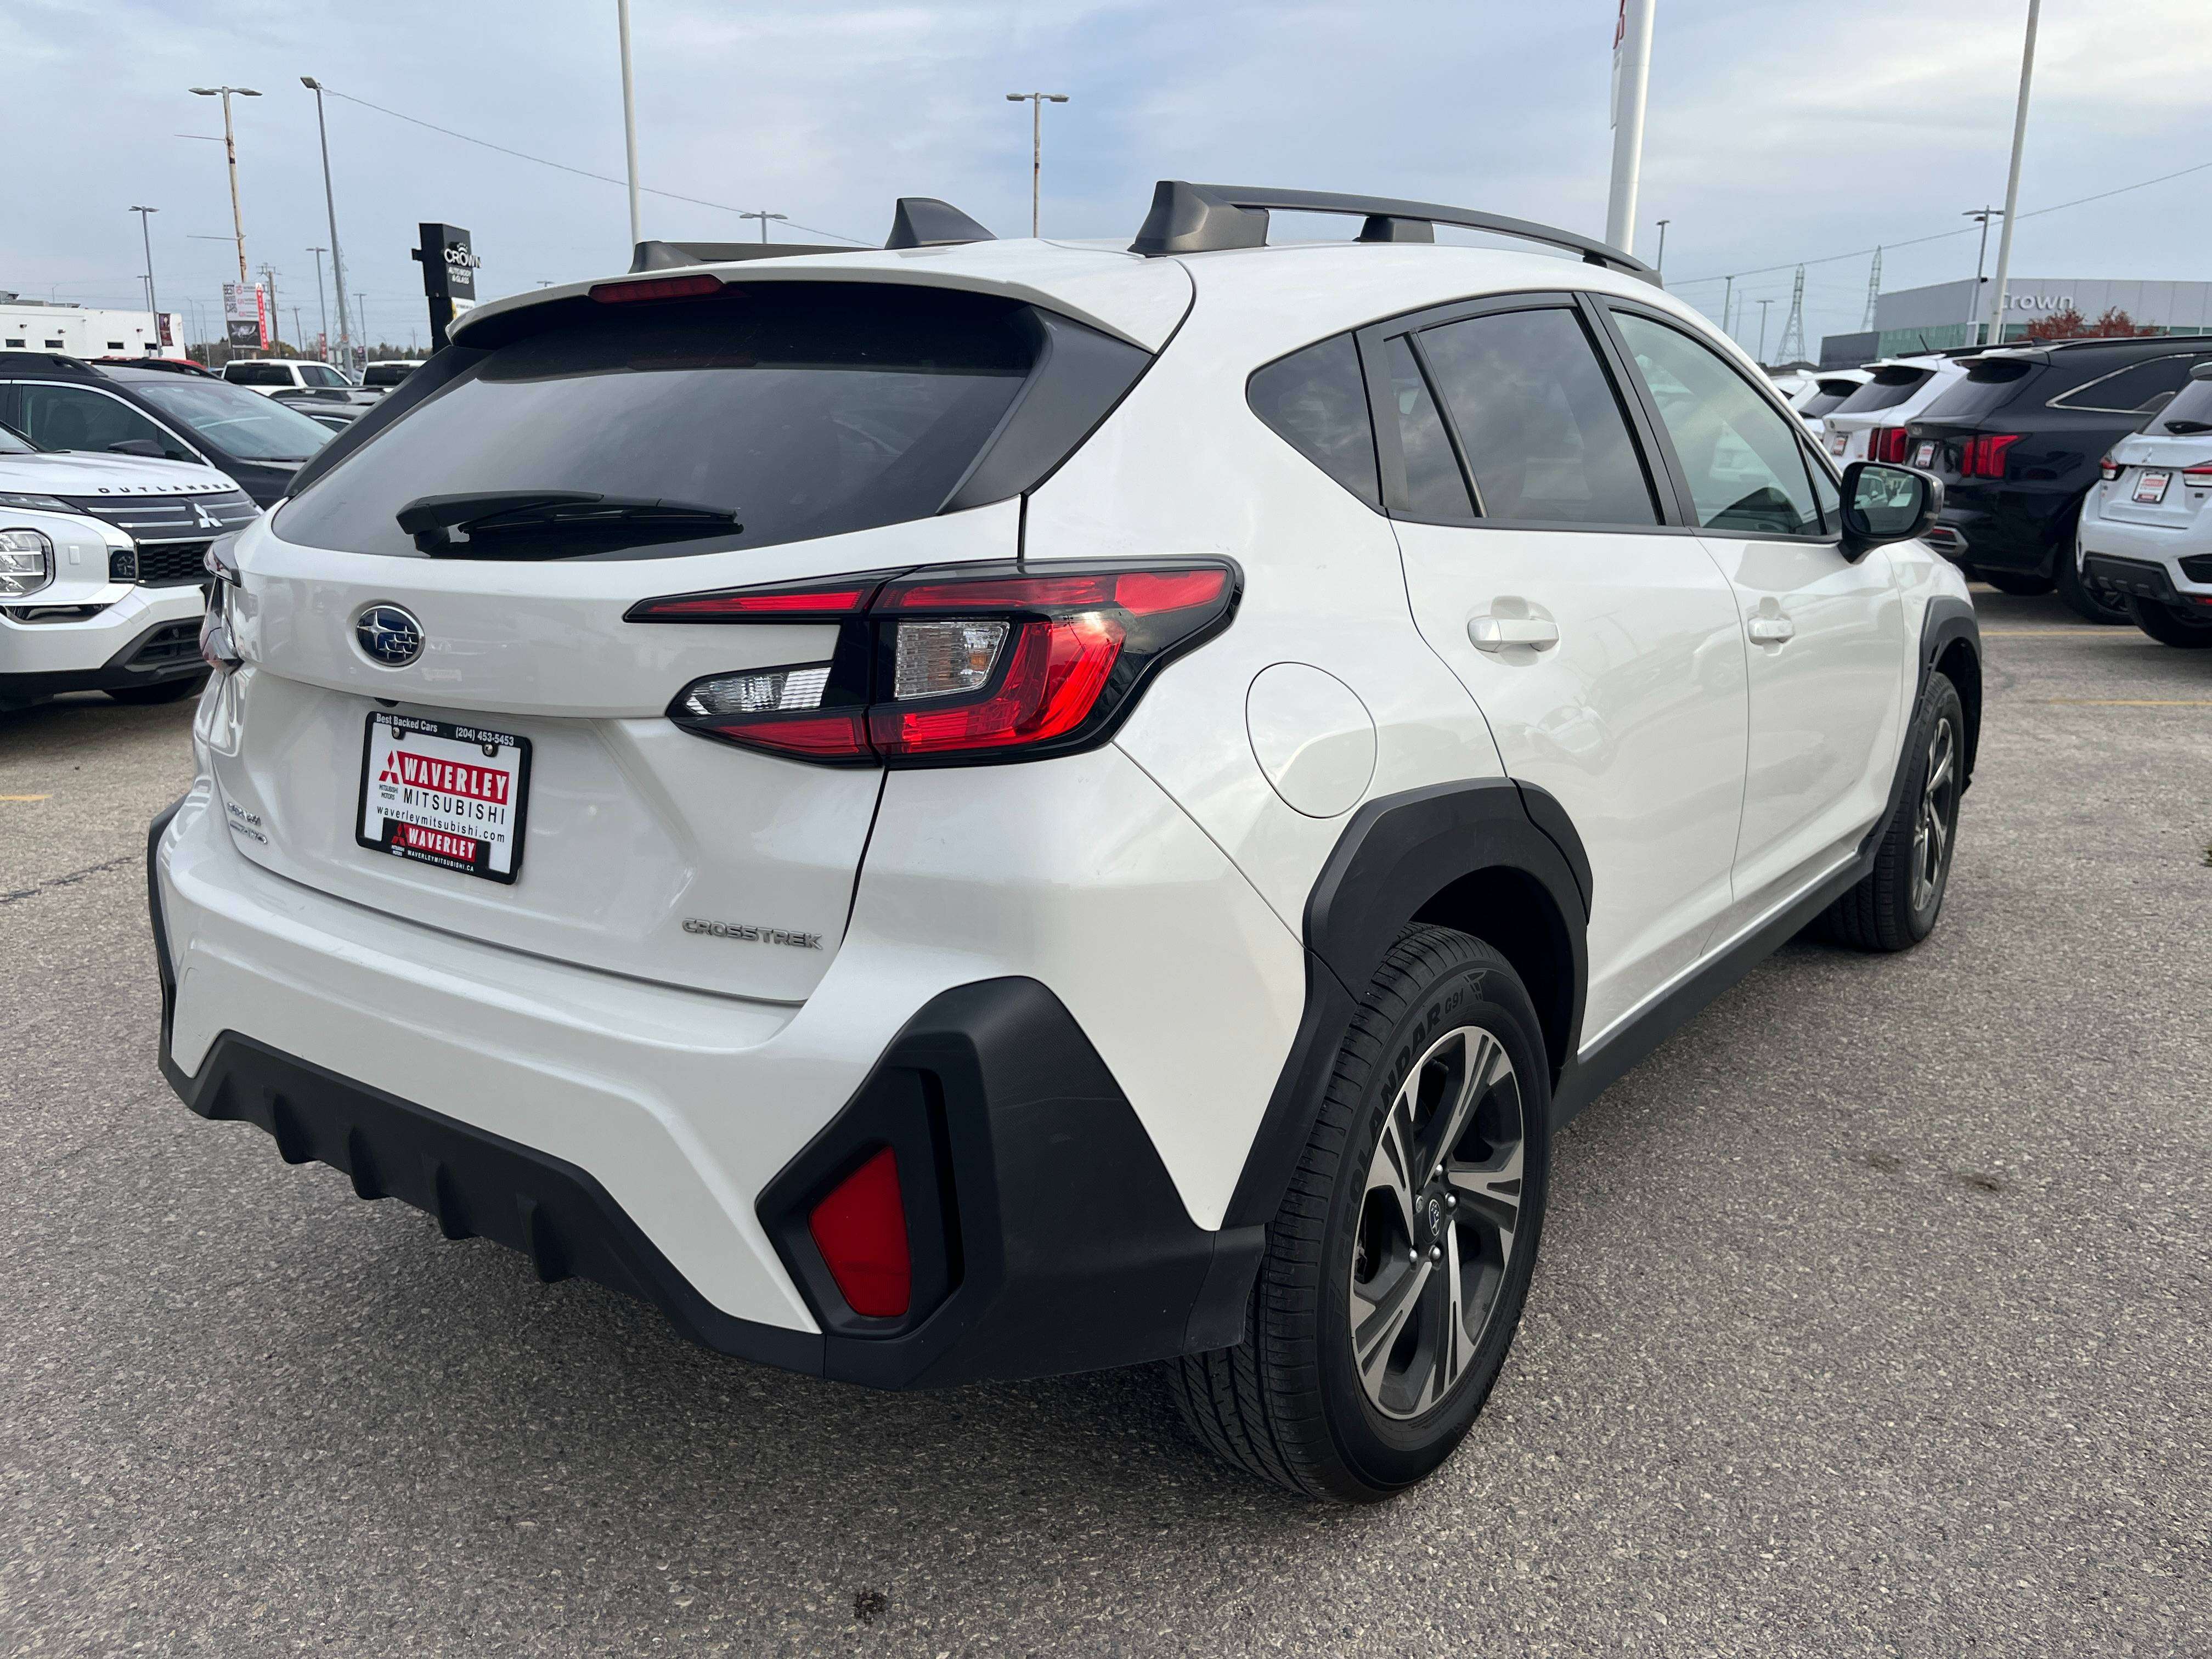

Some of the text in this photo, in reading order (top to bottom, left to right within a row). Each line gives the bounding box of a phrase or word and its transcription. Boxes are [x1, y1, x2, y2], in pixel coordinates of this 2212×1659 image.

[444, 248, 482, 268] CROWN
[2002, 292, 2074, 310] rown
[376, 713, 514, 746] Best Backed Cars (204) 453-5453
[403, 757, 507, 800] WAVERLEY
[403, 788, 505, 825] MITSUBISHI
[377, 805, 505, 843] waverleymitsubishi.com
[408, 827, 476, 859] WAVERLEY
[682, 918, 823, 950] CROSSTREK
